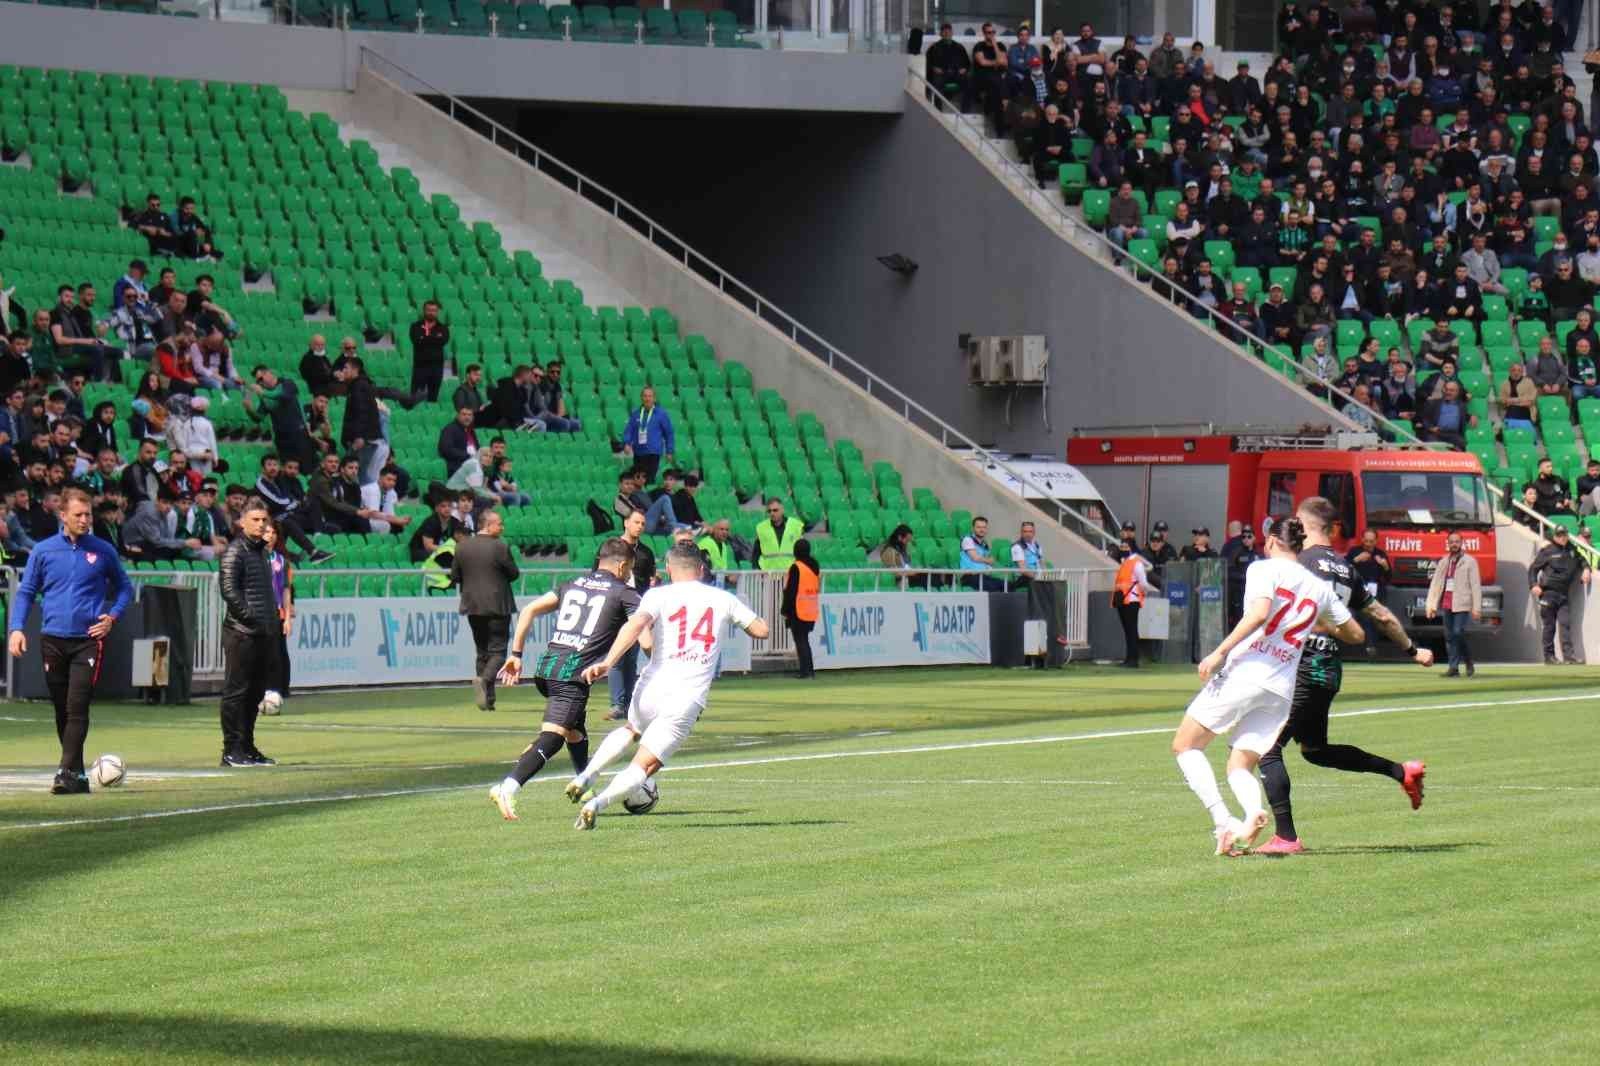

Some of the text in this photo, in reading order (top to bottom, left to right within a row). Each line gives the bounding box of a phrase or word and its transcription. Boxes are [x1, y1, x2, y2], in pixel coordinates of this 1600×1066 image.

[1385, 537, 1422, 551] İTFAİYE
[404, 611, 461, 646] ADATIP
[556, 589, 606, 637] 61
[668, 606, 716, 653] 14
[840, 606, 886, 638] ADATIP
[932, 605, 976, 634] ADATIP
[1264, 586, 1318, 650] 72
[298, 613, 356, 649] ADATIP
